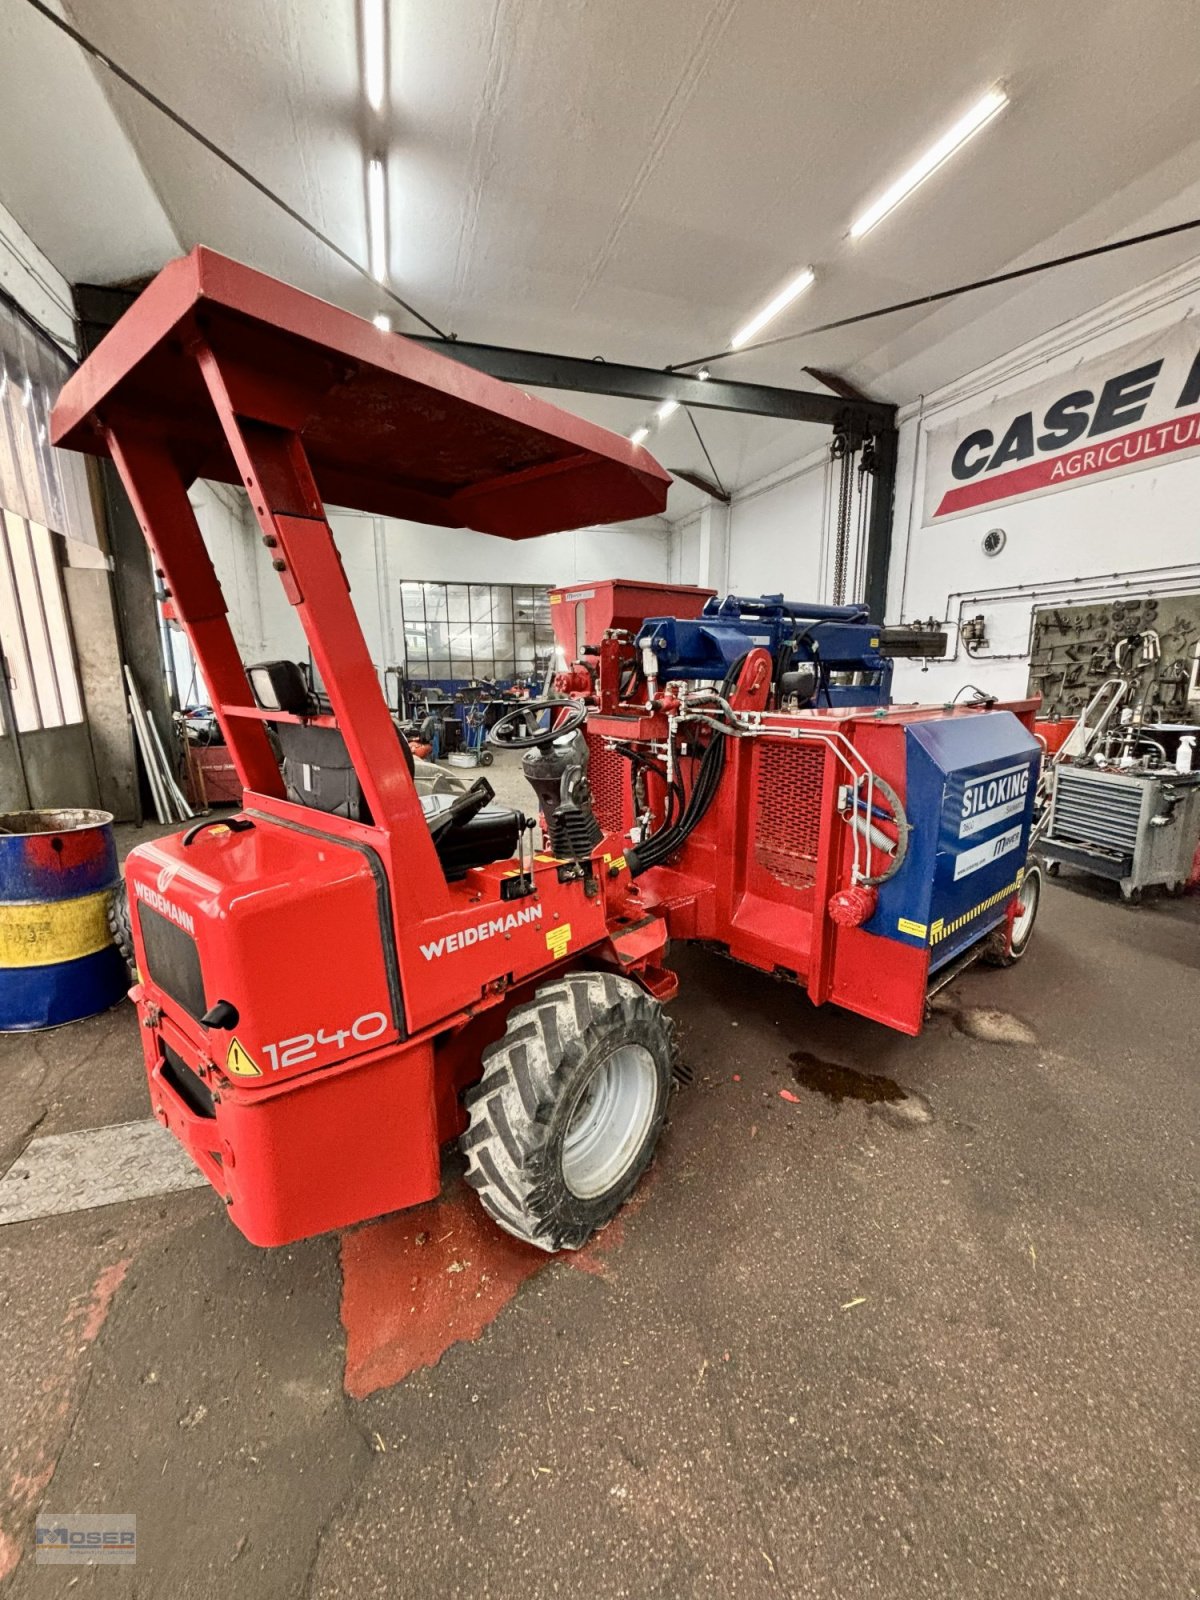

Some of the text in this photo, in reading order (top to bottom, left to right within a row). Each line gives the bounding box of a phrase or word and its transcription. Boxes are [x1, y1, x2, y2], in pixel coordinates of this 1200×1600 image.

[951, 358, 1165, 480] CASE
[961, 769, 1029, 818] SILOKING
[133, 879, 195, 935] WEIDEMANN
[419, 904, 542, 961] WEIDEMANN
[262, 1012, 388, 1071] 1240
